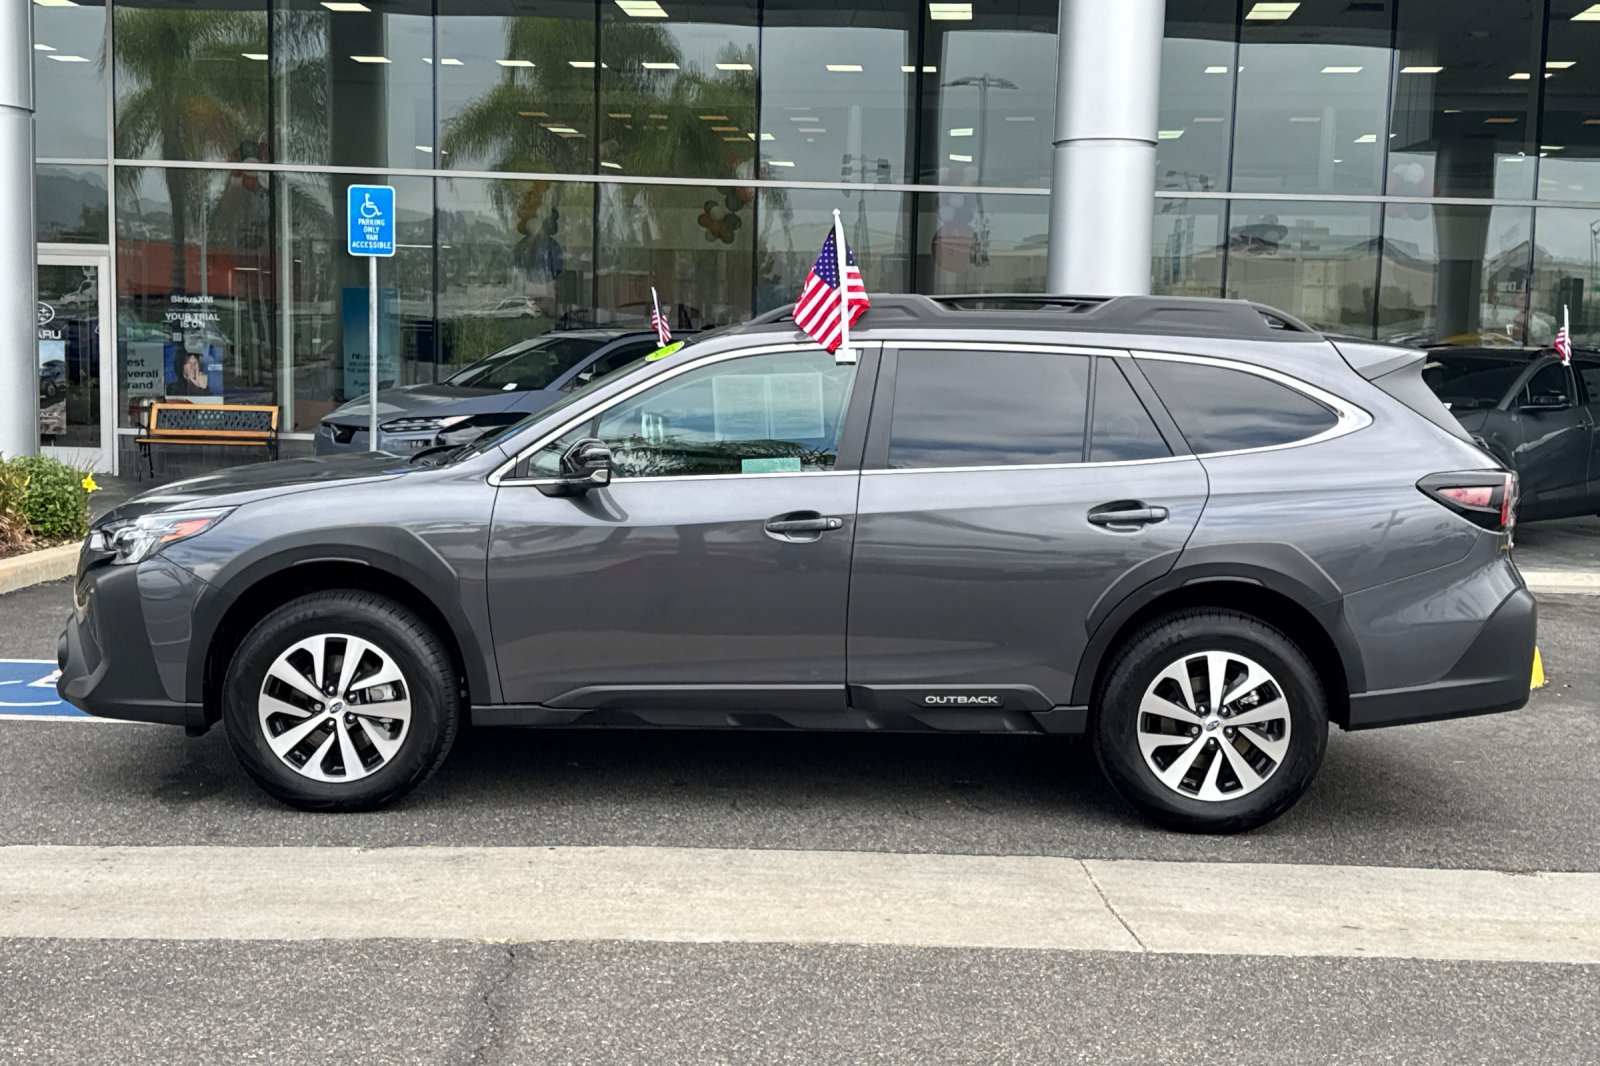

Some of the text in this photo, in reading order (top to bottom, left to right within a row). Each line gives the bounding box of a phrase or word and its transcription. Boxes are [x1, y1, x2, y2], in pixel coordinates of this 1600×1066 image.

[357, 217, 386, 227] PARKING
[363, 226, 380, 234] ONLY
[365, 233, 378, 241] VAN
[351, 241, 392, 249] ACCESSIBLE
[170, 295, 214, 303] SiriusXM
[165, 312, 221, 321] YOUR TRIAL
[180, 320, 206, 328] IS ON
[127, 358, 145, 367] est
[127, 369, 159, 378] verall
[127, 380, 153, 389] rand
[925, 695, 999, 704] OUTBACK
